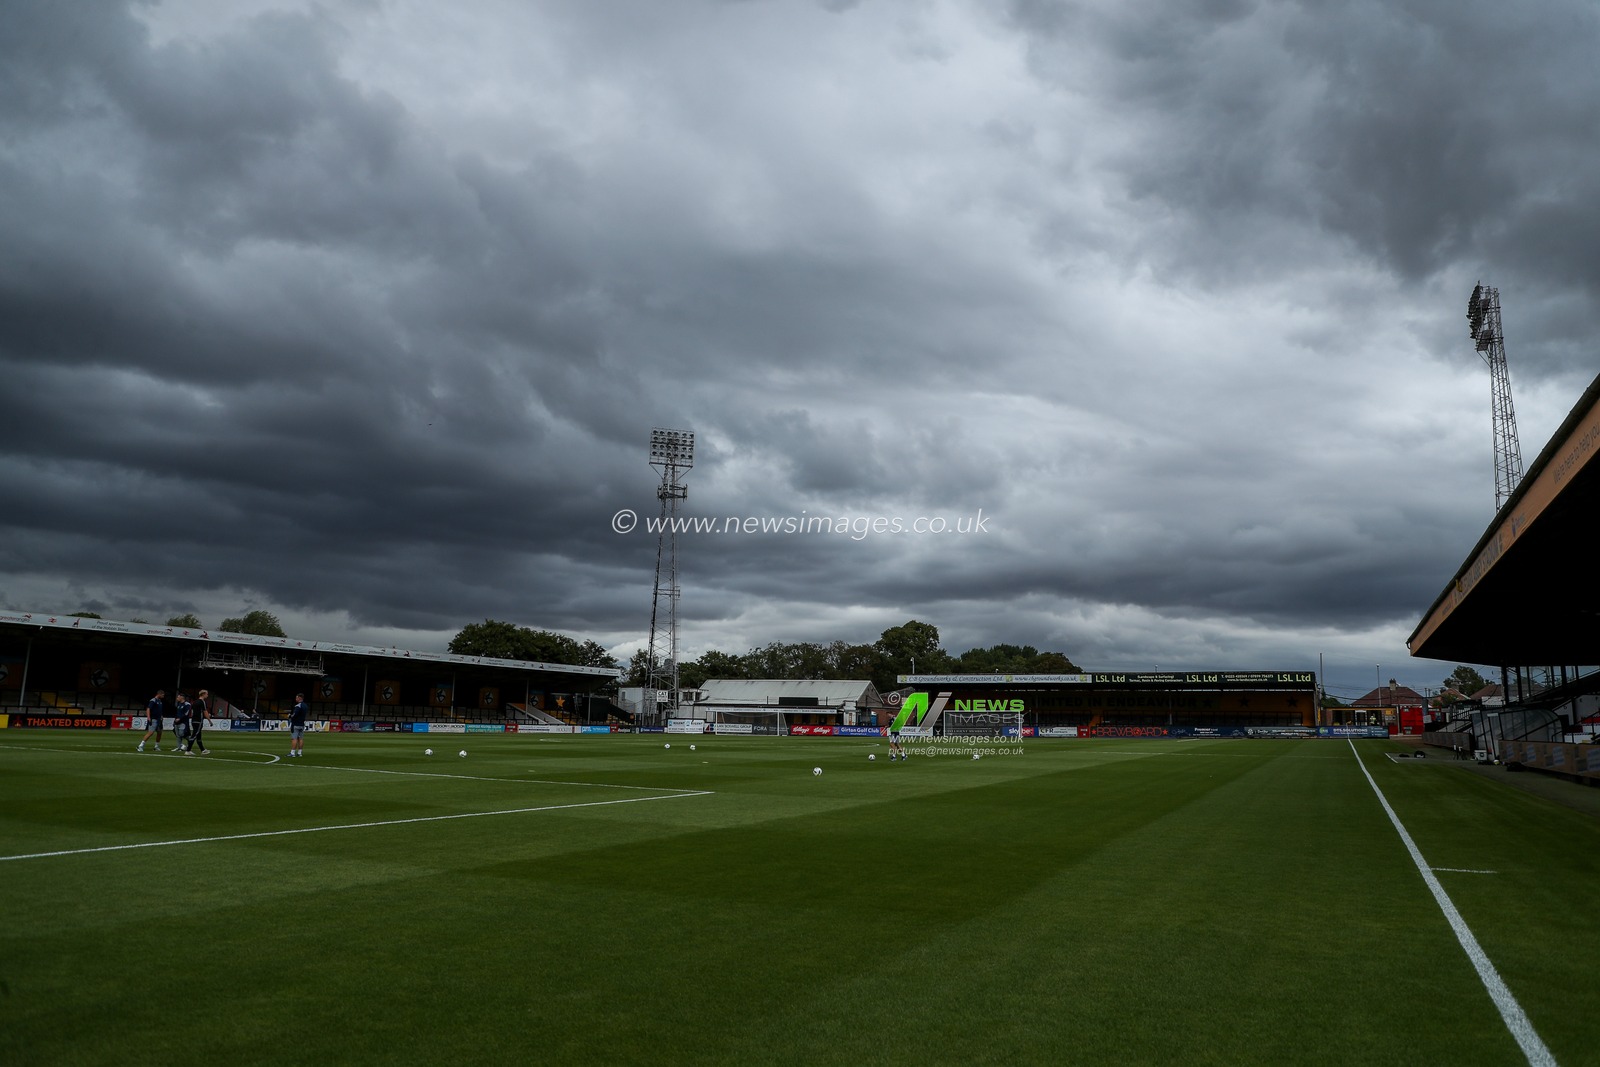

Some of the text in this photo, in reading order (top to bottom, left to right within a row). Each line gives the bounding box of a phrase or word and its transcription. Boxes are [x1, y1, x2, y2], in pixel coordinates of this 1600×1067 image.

[1095, 675, 1126, 683] LSL Ltd
[1186, 674, 1218, 683] LSL Ltd
[1277, 674, 1311, 682] LSL Ltd
[1088, 697, 1102, 707] IN
[1107, 697, 1196, 707] ENDEAVOUR
[27, 718, 107, 727] THAXTED STOVES
[793, 726, 810, 734] Kellogg's
[1096, 726, 1163, 737] BREWBOARD
